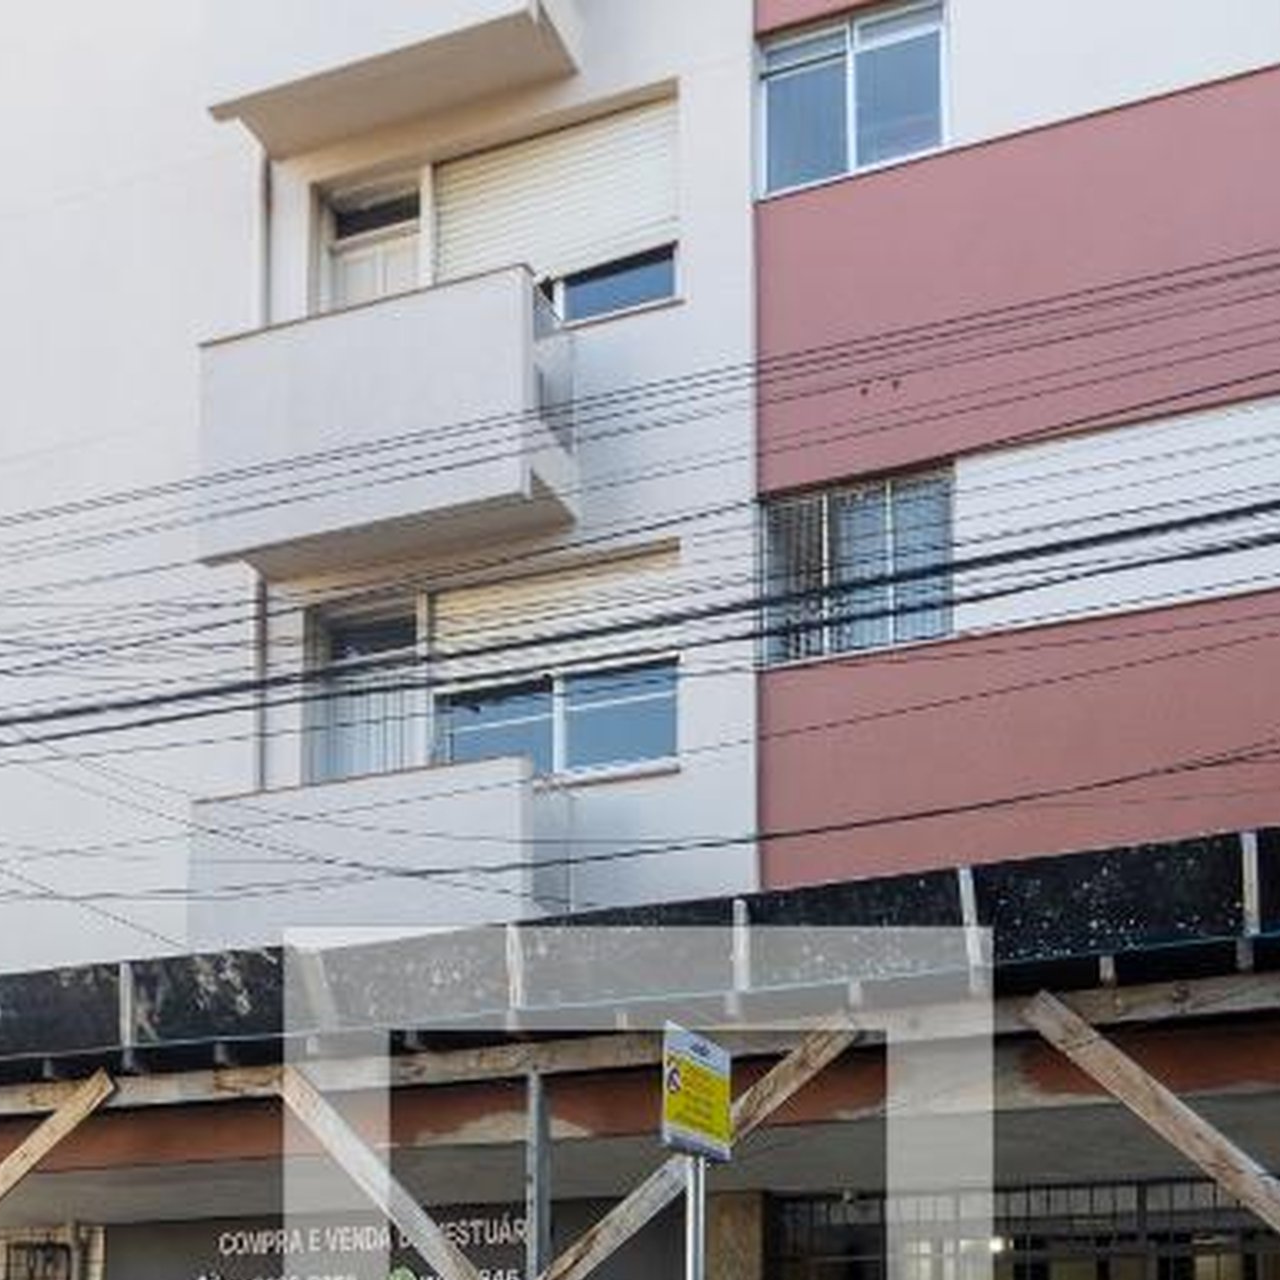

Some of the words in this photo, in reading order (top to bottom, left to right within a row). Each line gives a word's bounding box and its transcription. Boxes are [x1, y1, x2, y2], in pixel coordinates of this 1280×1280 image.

[218, 1226, 304, 1256] COMPRA
[309, 1226, 322, 1252] E
[326, 1223, 392, 1252] VENDA
